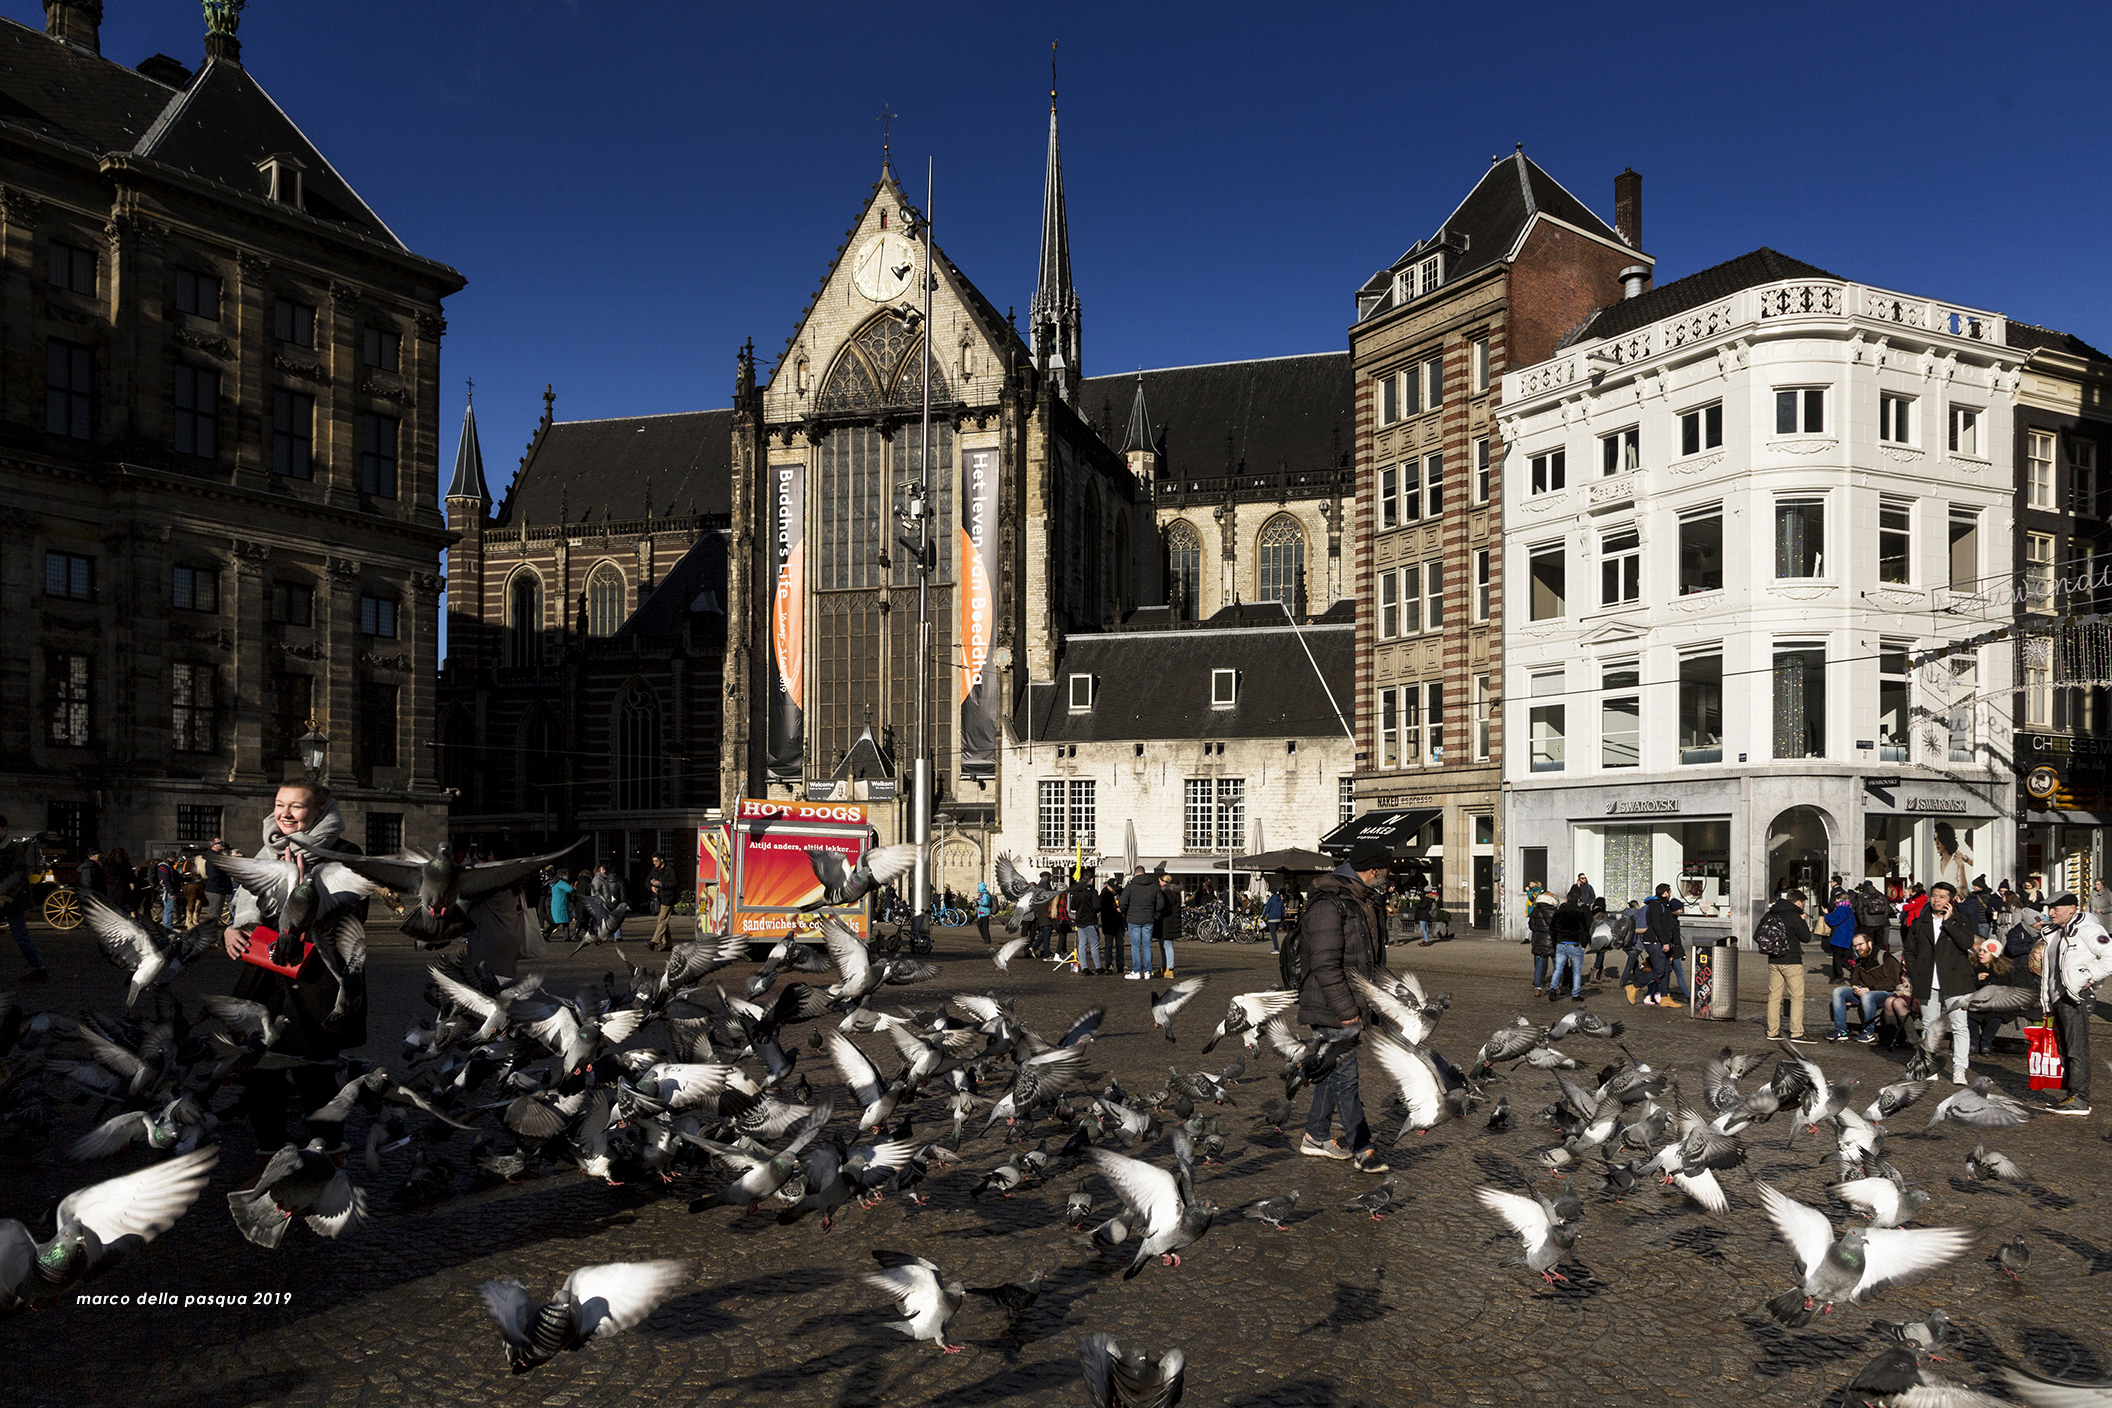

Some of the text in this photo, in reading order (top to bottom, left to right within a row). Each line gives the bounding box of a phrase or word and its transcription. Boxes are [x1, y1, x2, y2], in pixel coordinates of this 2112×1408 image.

[777, 469, 794, 599] Buddha's Life
[971, 453, 988, 686] Het leven van Boeddha
[778, 624, 786, 639] sep
[1378, 795, 1433, 808] NAKED espresso
[1619, 799, 1681, 813] SWAROVSKI
[1918, 798, 1967, 812] SWAROVSKI
[743, 801, 861, 822] HOT DOGS
[1359, 826, 1397, 835] NAKED
[749, 842, 772, 850] Altijd
[773, 843, 802, 852] anders,
[743, 917, 797, 931] sandwiches
[799, 920, 807, 928] &
